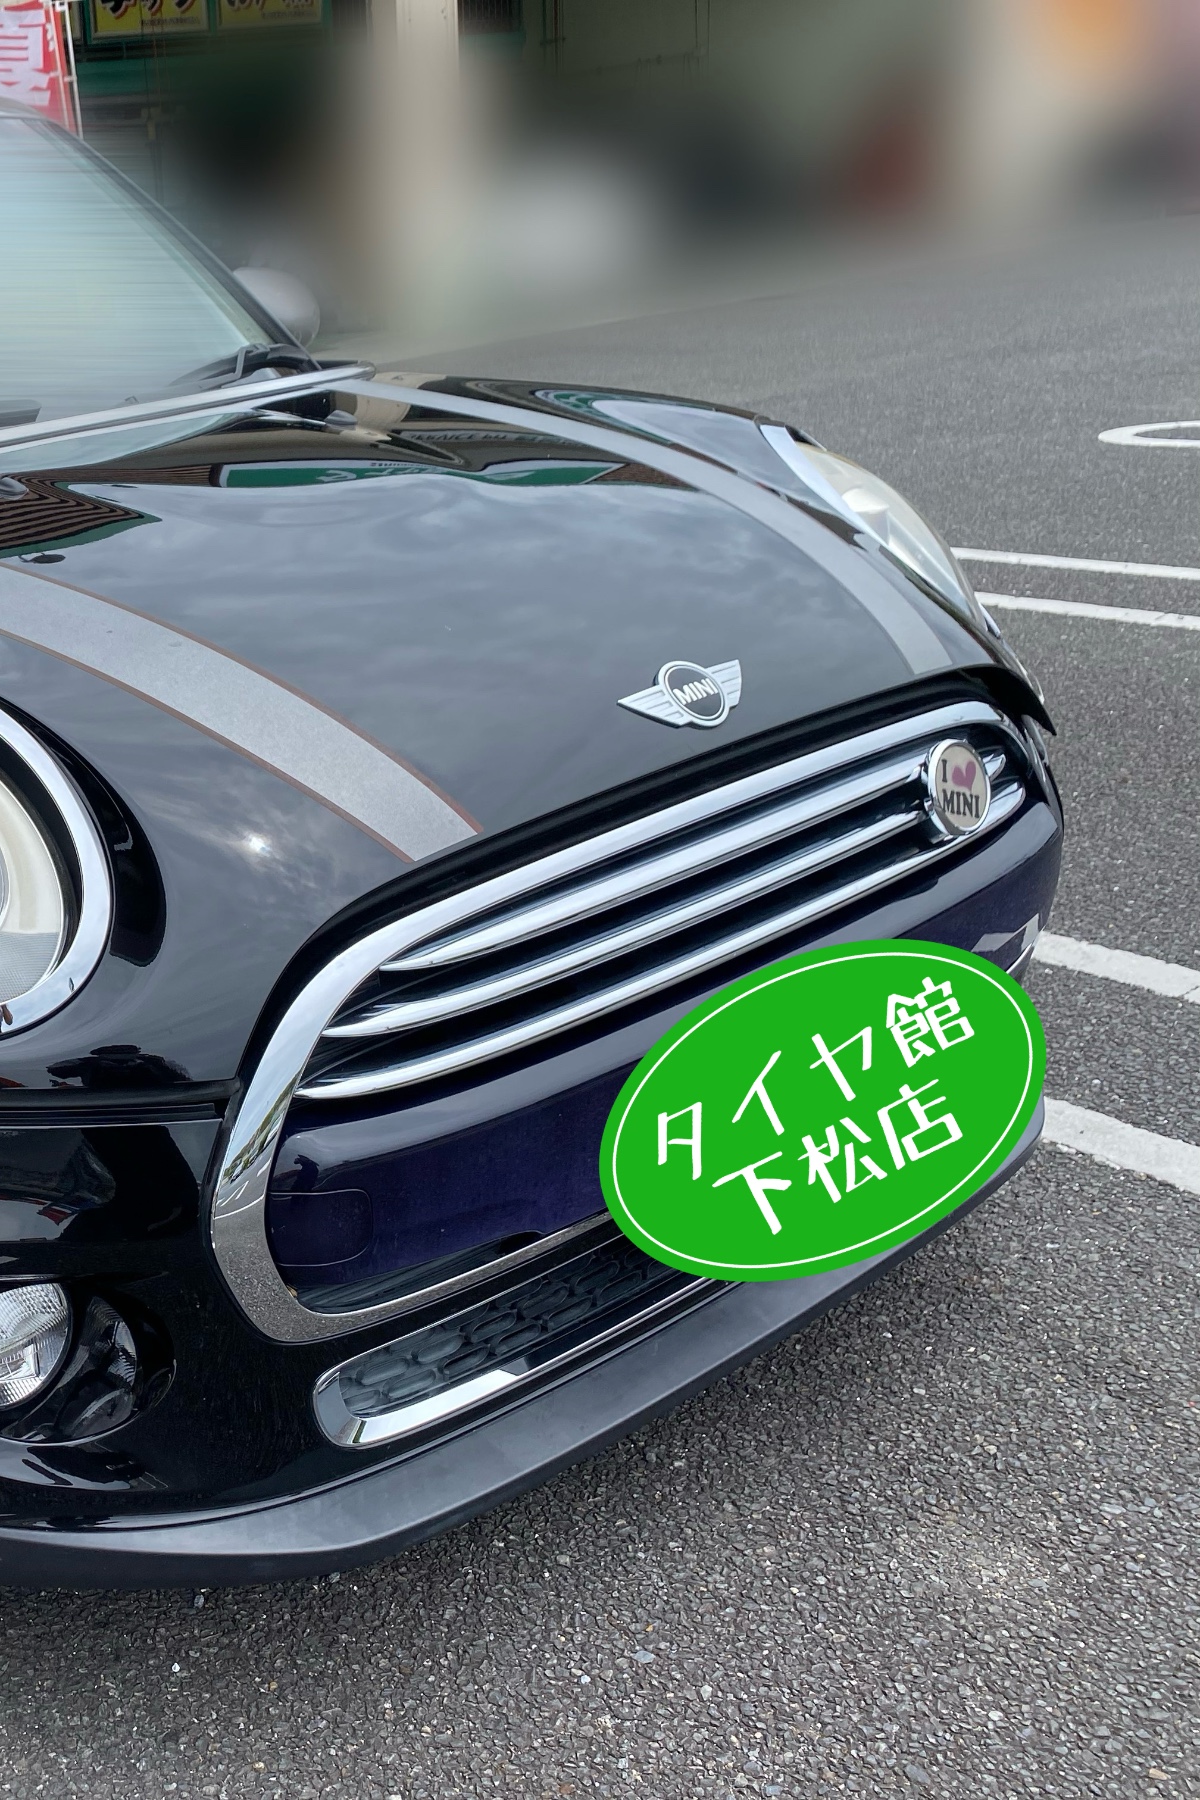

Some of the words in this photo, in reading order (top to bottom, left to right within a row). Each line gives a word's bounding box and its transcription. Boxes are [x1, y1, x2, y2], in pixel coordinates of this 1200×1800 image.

[671, 676, 716, 707] MINI
[940, 758, 948, 784] I
[941, 788, 981, 819] MINI
